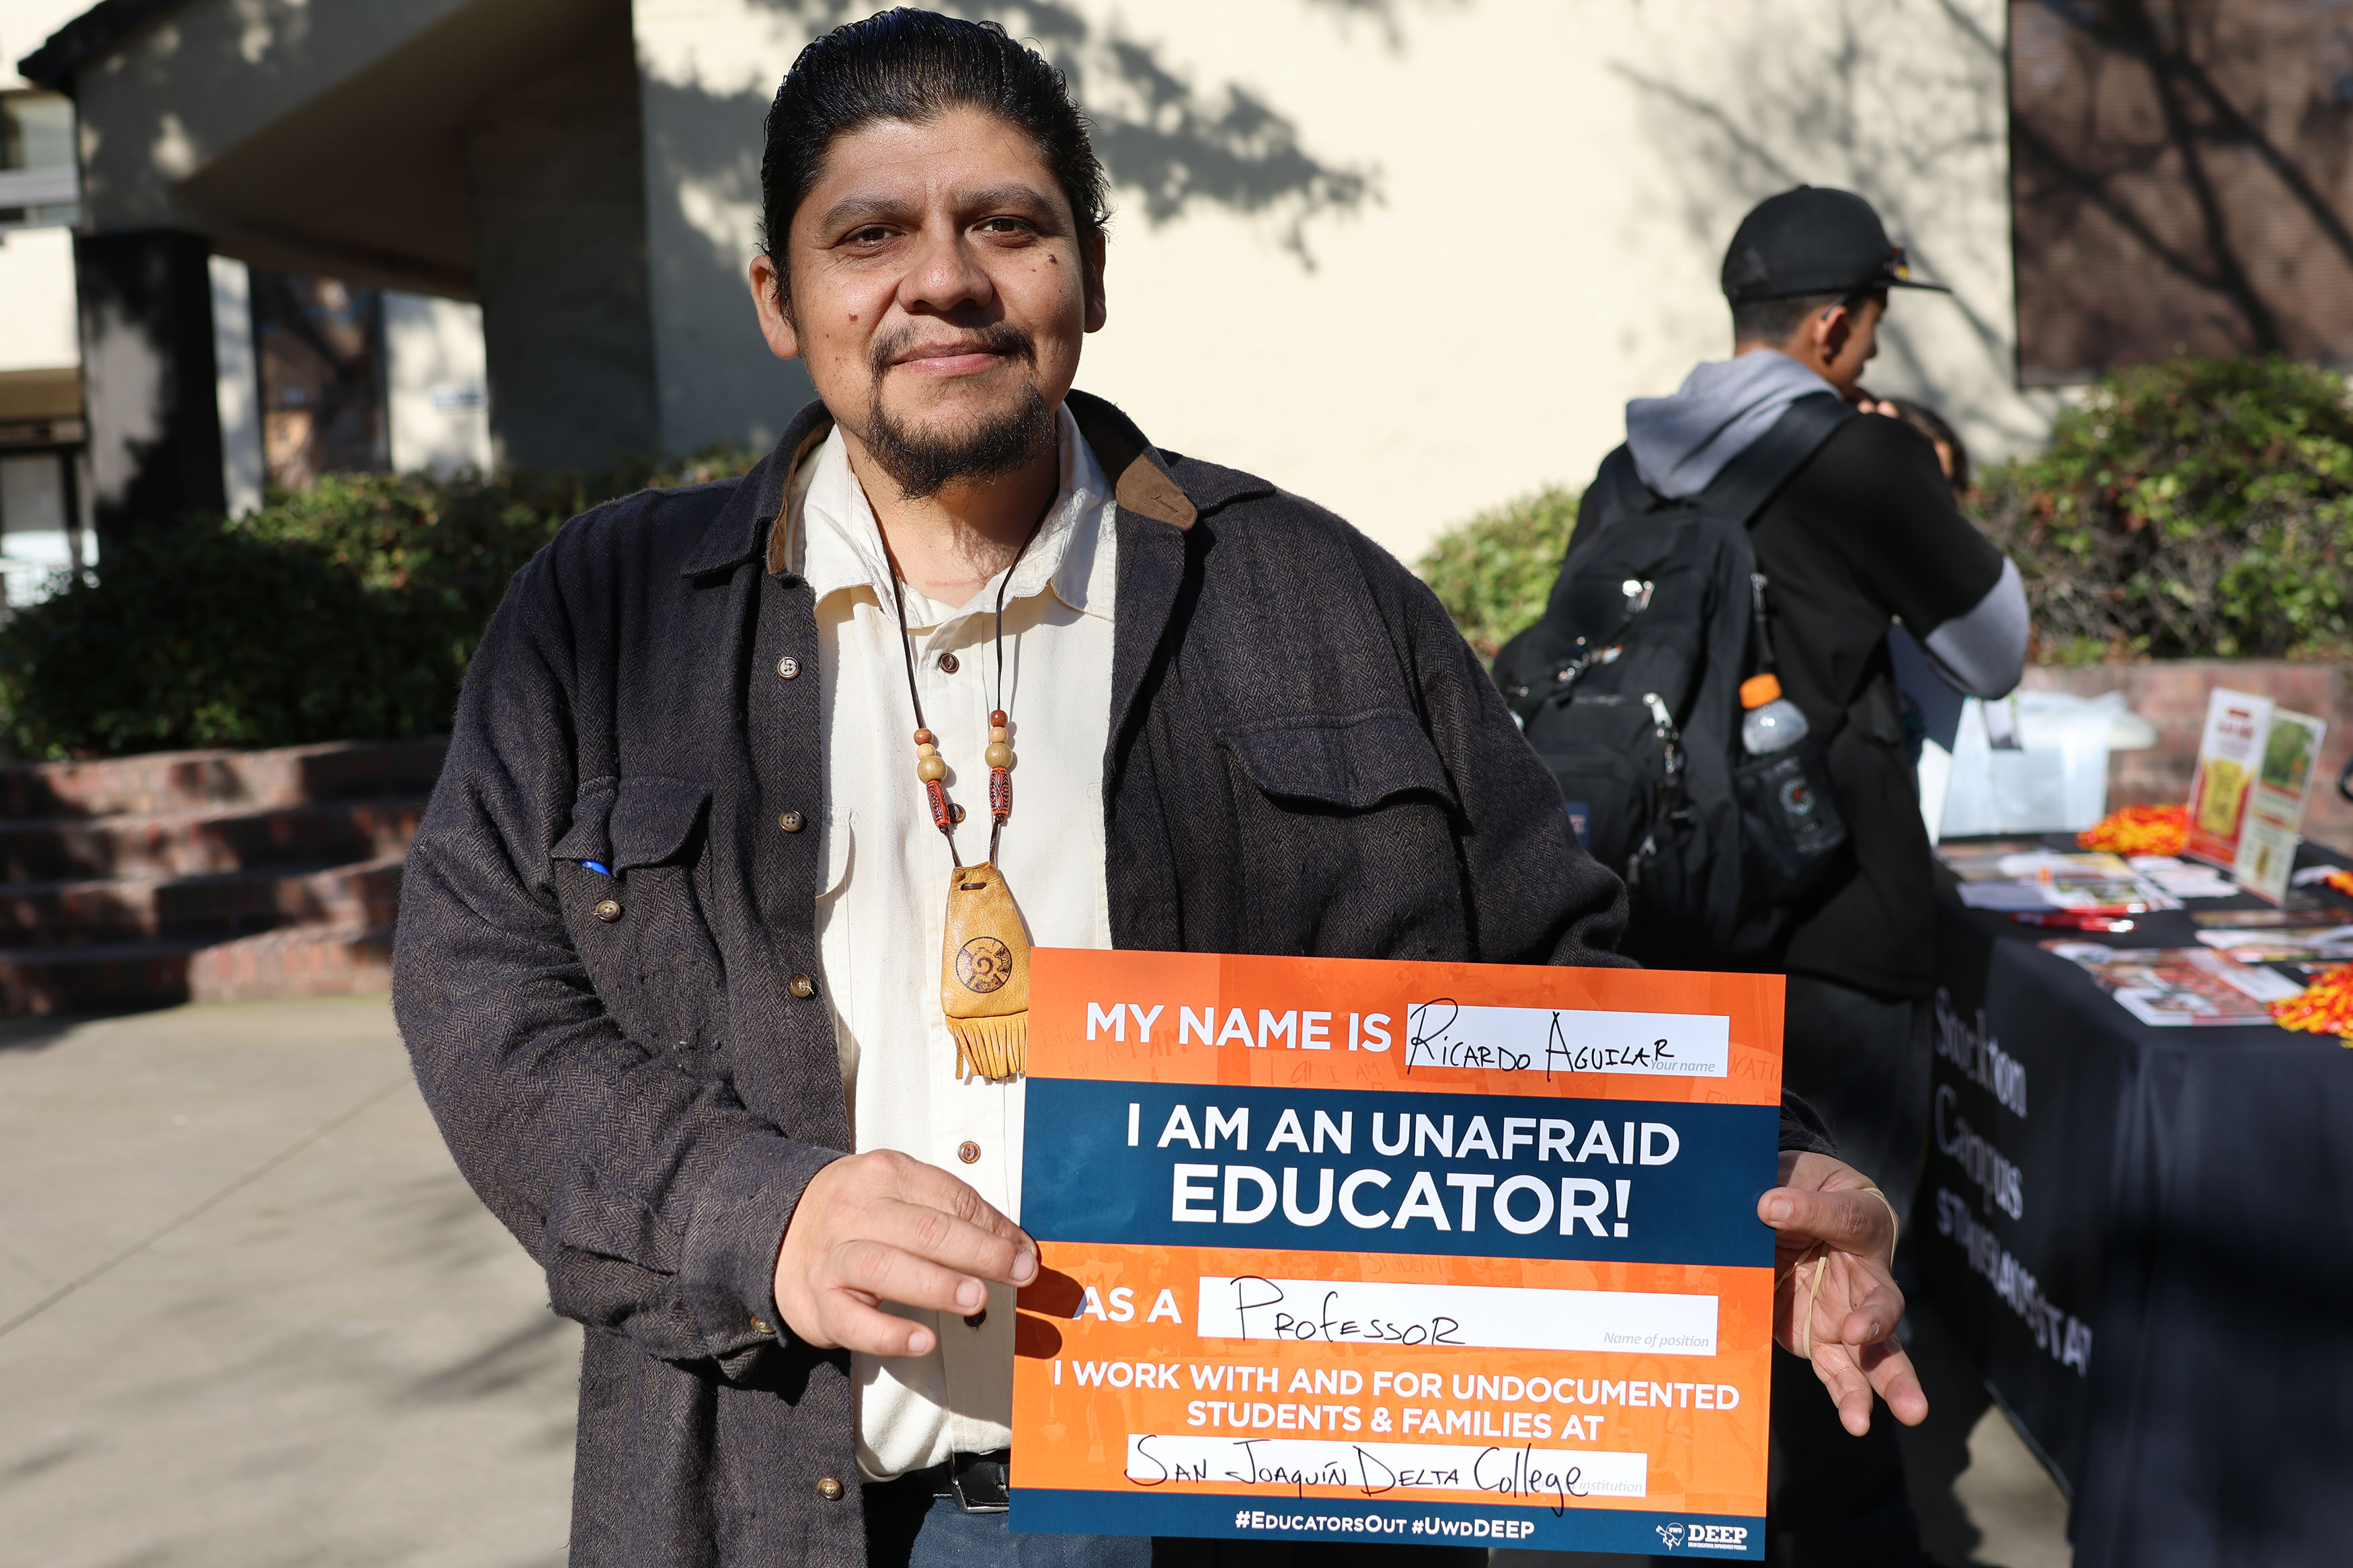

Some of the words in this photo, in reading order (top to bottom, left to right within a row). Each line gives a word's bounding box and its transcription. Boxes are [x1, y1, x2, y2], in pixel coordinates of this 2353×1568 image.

[1086, 1002, 1164, 1042] MY
[1179, 1006, 1331, 1050] NAME
[1349, 1013, 1391, 1052] IS
[1650, 1059, 1678, 1071] Your
[1680, 1062, 1716, 1073] name
[1128, 1104, 1140, 1146] I
[1157, 1105, 1248, 1150] AM
[1266, 1109, 1352, 1153] AN
[1373, 1112, 1679, 1165] UNAFRAID
[1172, 1163, 1630, 1238] EDUCATOR!
[1072, 1286, 1135, 1322] AS
[1147, 1289, 1182, 1323] A
[1603, 1332, 1641, 1345] Name
[1644, 1333, 1659, 1348] of
[1659, 1335, 1710, 1348] position
[1054, 1360, 1062, 1385] I
[1072, 1360, 1181, 1389] WORK
[1189, 1364, 1279, 1393] WITH
[1288, 1368, 1363, 1395] AND
[1373, 1371, 1442, 1399] FOR
[1453, 1374, 1740, 1410] UNDOCUMENTED
[1187, 1401, 1361, 1432] STUDENTS
[1370, 1407, 1392, 1432] &
[1402, 1408, 1552, 1439] FAMILIES
[1560, 1415, 1604, 1441] AT
[1474, 1442, 1589, 1518] College
[1579, 1478, 1642, 1493] institution
[1687, 1524, 1747, 1544] DEEP
